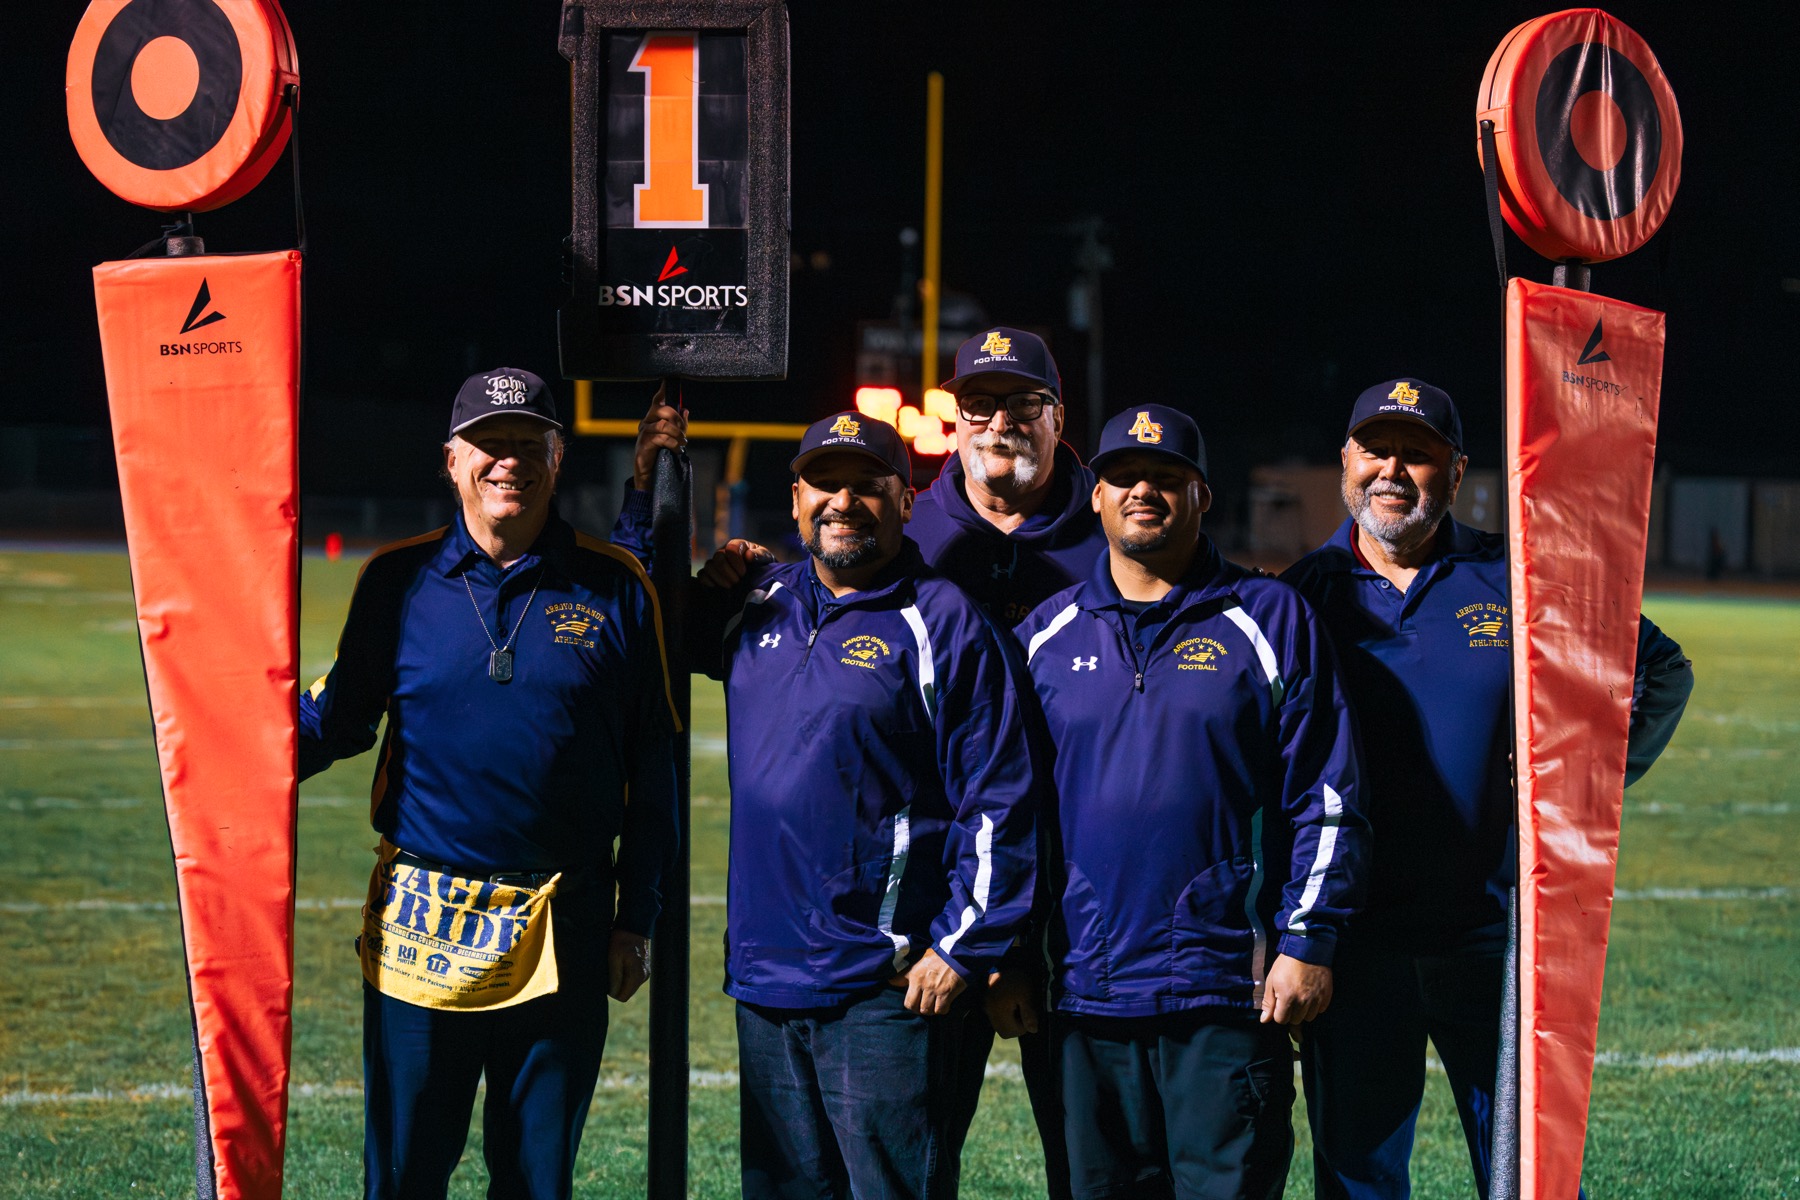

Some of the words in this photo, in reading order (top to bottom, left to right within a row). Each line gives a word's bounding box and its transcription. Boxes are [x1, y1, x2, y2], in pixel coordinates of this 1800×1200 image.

[627, 31, 709, 229] 1
[598, 285, 654, 307] BSN
[657, 285, 748, 307] SPORTS
[160, 343, 191, 356] BSN
[193, 341, 243, 355] SPORTS
[973, 355, 1018, 366] FOOTBALL
[485, 374, 528, 395] John
[1562, 370, 1585, 386] BSN
[1585, 376, 1621, 396] SPORTS
[490, 390, 526, 406] 3:16
[1378, 405, 1426, 416] FOOTBALL
[821, 437, 867, 446] FOOTBALL
[544, 602, 573, 616] ARROYO
[575, 603, 606, 622] GRANDE
[1455, 602, 1484, 619] ARROYO
[1486, 602, 1509, 616] GRAN
[841, 635, 871, 649] ARROYO
[870, 636, 891, 656] GRANDE
[1173, 637, 1201, 655] ARROYO
[1201, 637, 1228, 656] GRANDE
[1469, 638, 1509, 648] ATHLETICS
[840, 657, 876, 670] FOOTBALL
[1177, 663, 1218, 671] FOOTBALL
[397, 944, 418, 961] RA
[418, 935, 439, 949] CULVER
[439, 941, 454, 954] CITY
[457, 947, 487, 961] DECEMBER
[430, 957, 448, 973] TF
